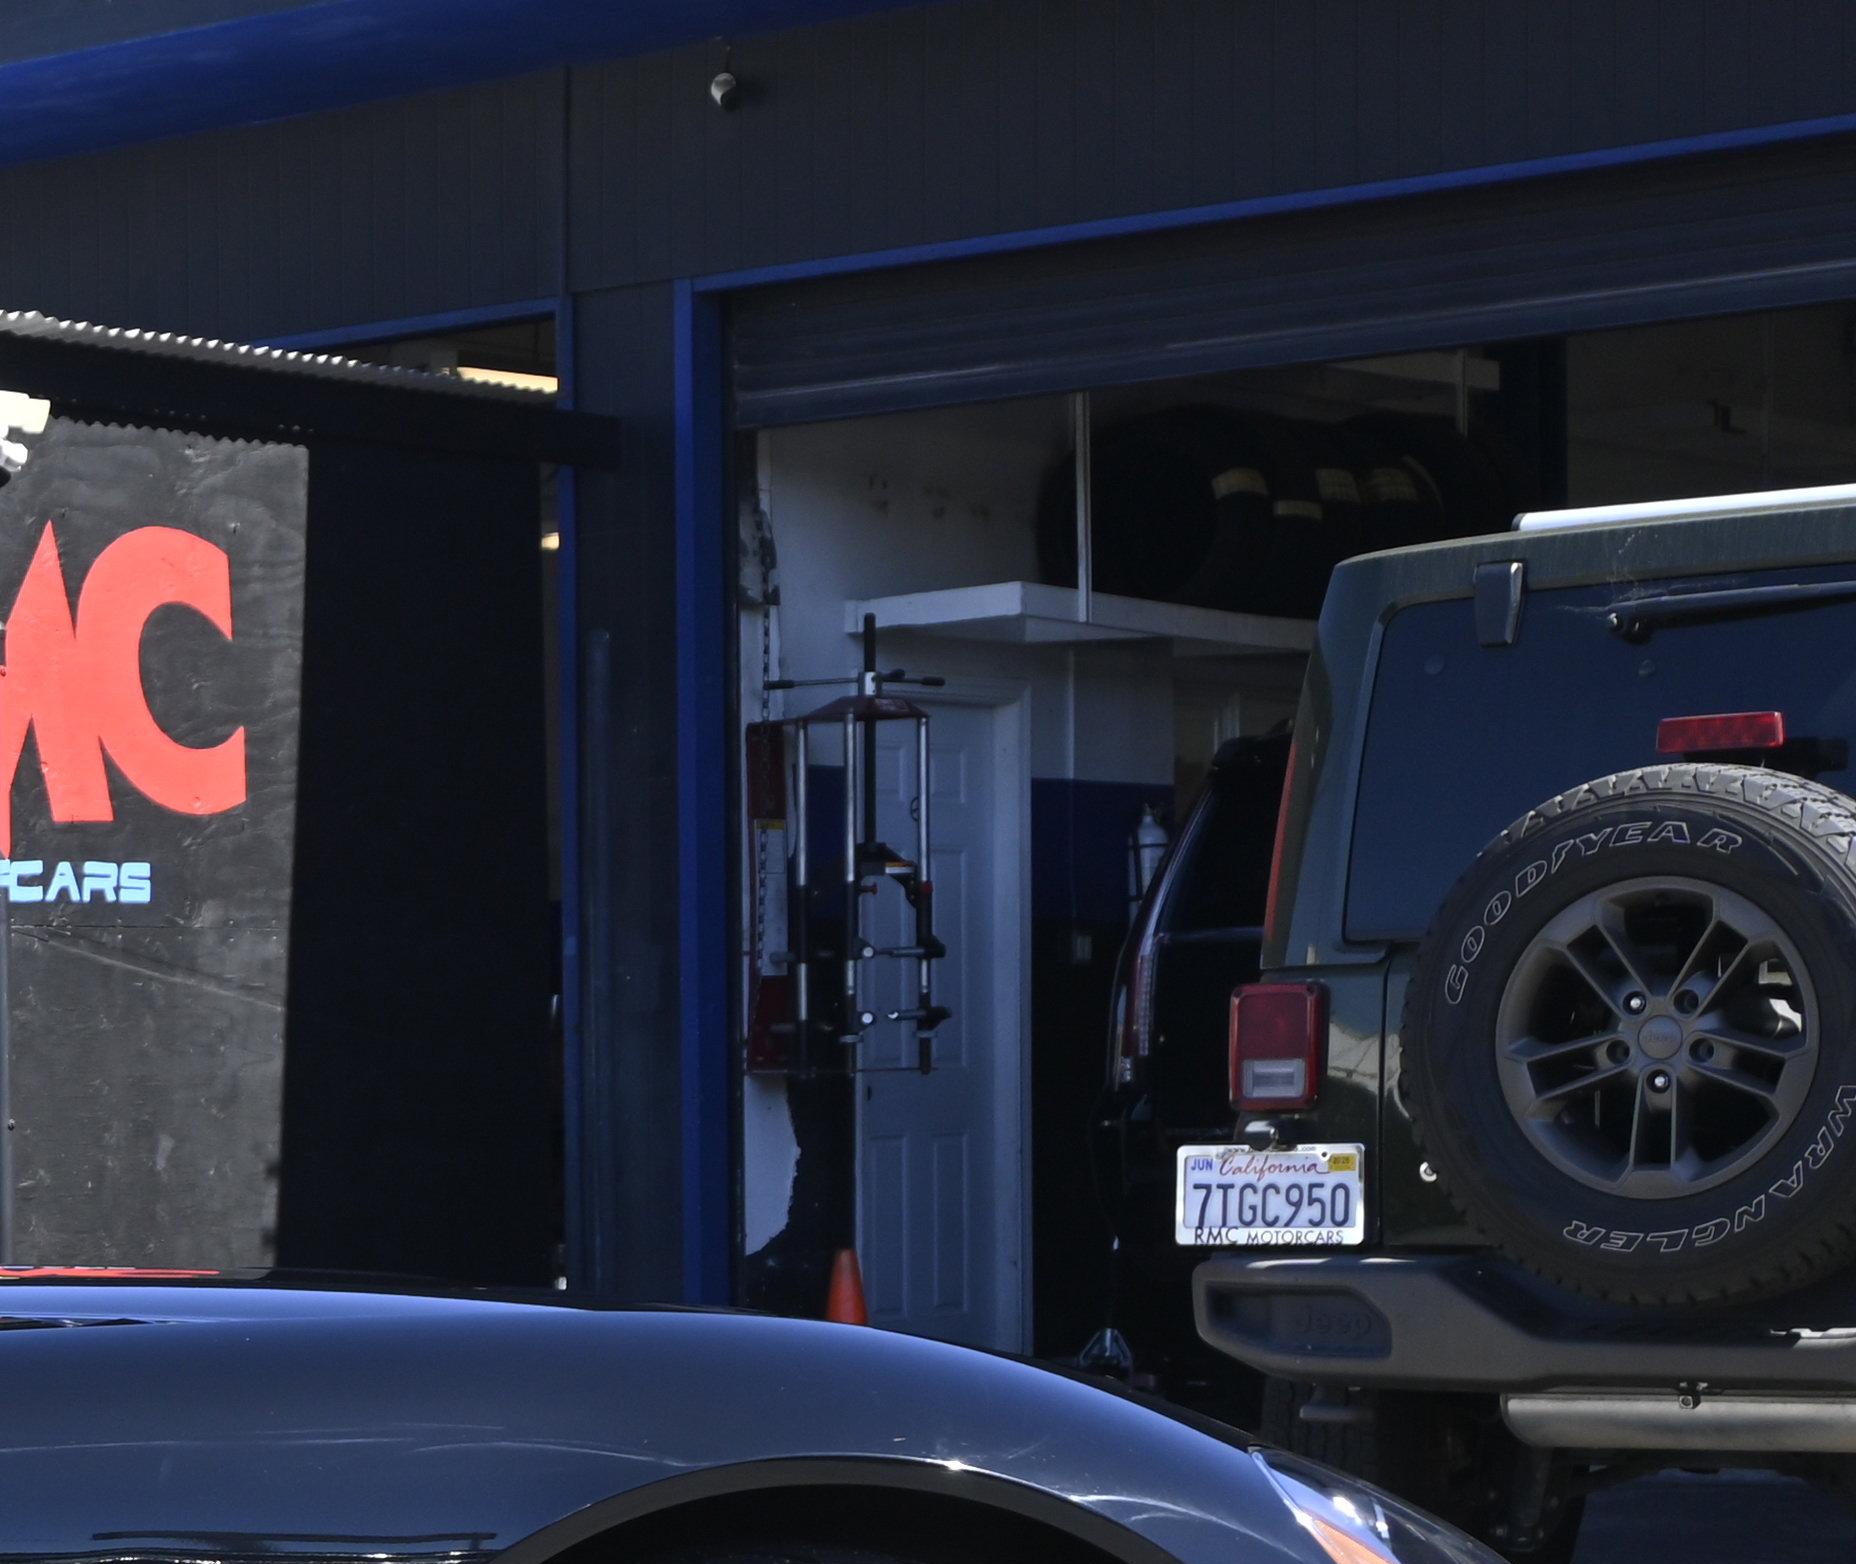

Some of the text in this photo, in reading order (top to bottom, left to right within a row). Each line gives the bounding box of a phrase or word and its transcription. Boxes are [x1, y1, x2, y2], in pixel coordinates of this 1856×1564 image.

[1444, 820, 1743, 1004] GOODYEAR
[1191, 1158, 1213, 1172] JUN
[1219, 1154, 1331, 1182] California
[1192, 1182, 1350, 1228] 7TGC950
[1195, 1226, 1344, 1244] RMC MOTORCARS
